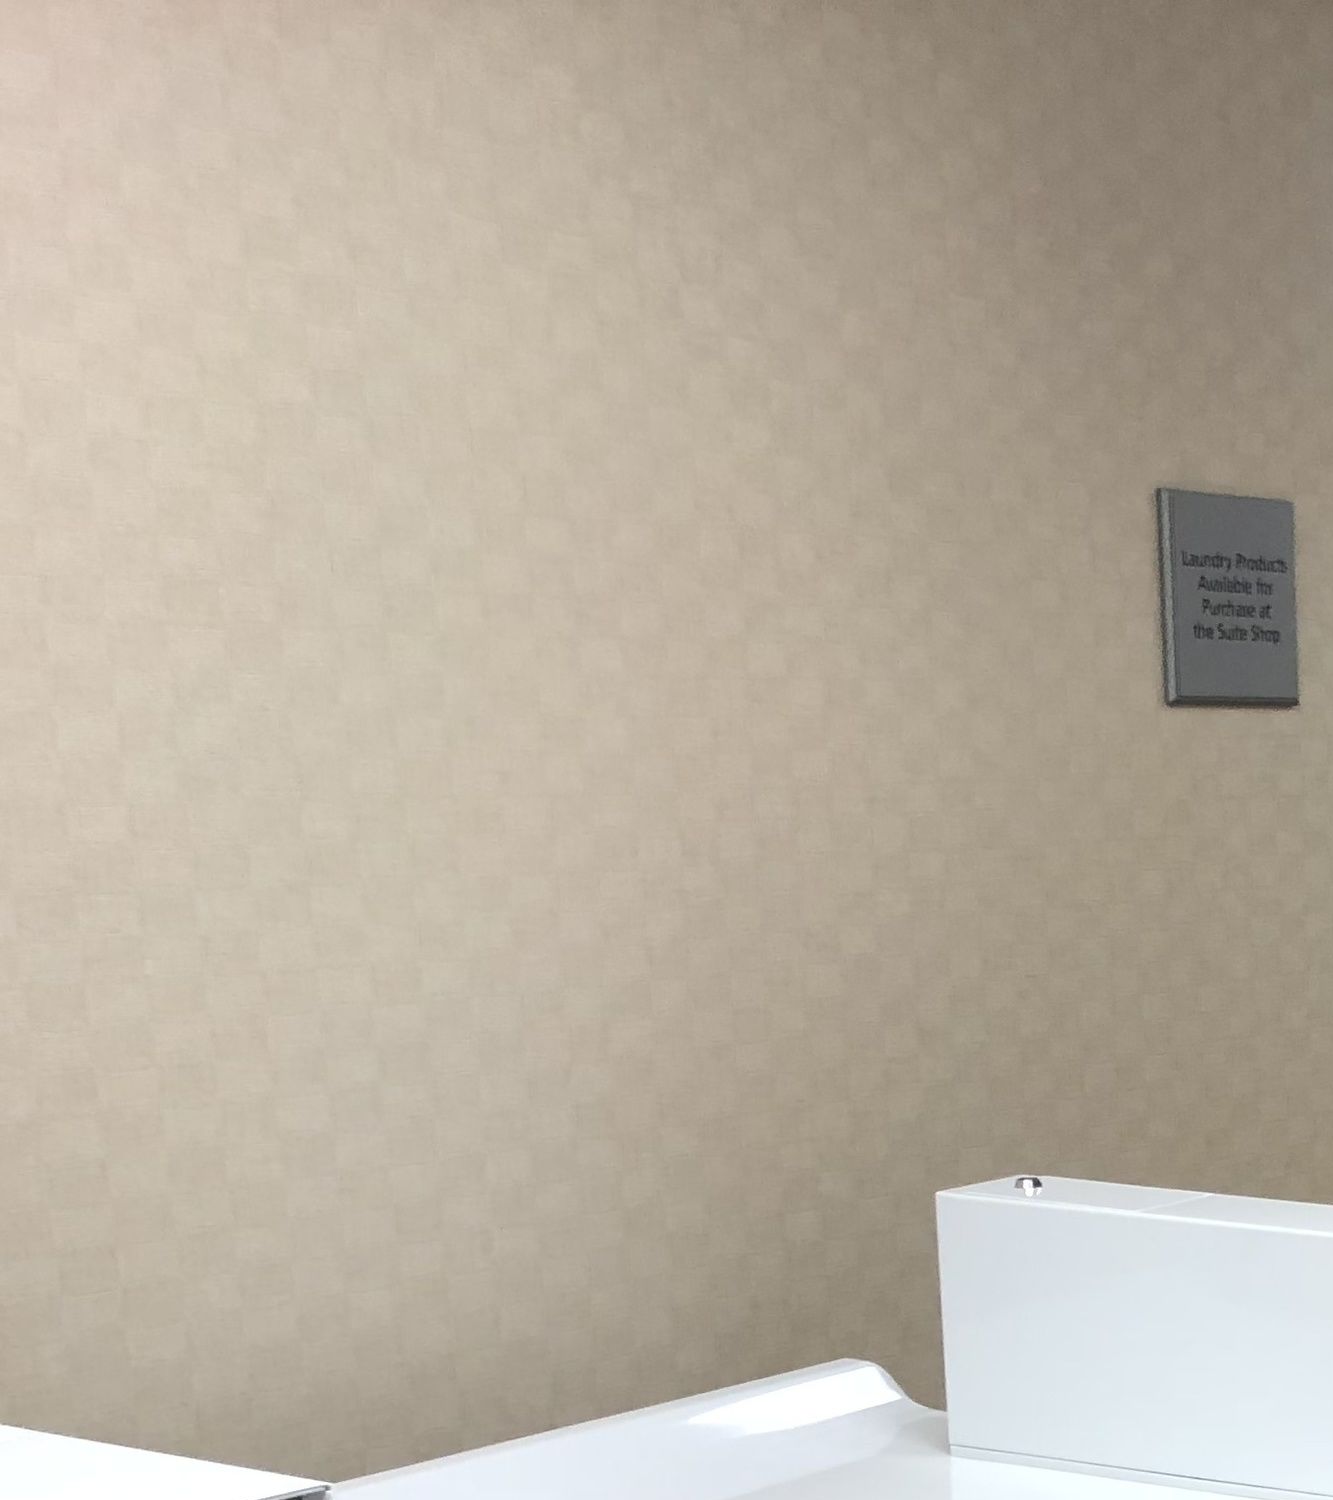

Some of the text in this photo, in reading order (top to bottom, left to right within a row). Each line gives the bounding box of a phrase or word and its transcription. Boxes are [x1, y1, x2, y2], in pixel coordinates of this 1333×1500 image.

[1181, 551, 1288, 574] Laundry Products
[1197, 575, 1274, 596] Available for
[1202, 599, 1272, 620] Purchase at
[1193, 623, 1281, 645] the Suite Shop
